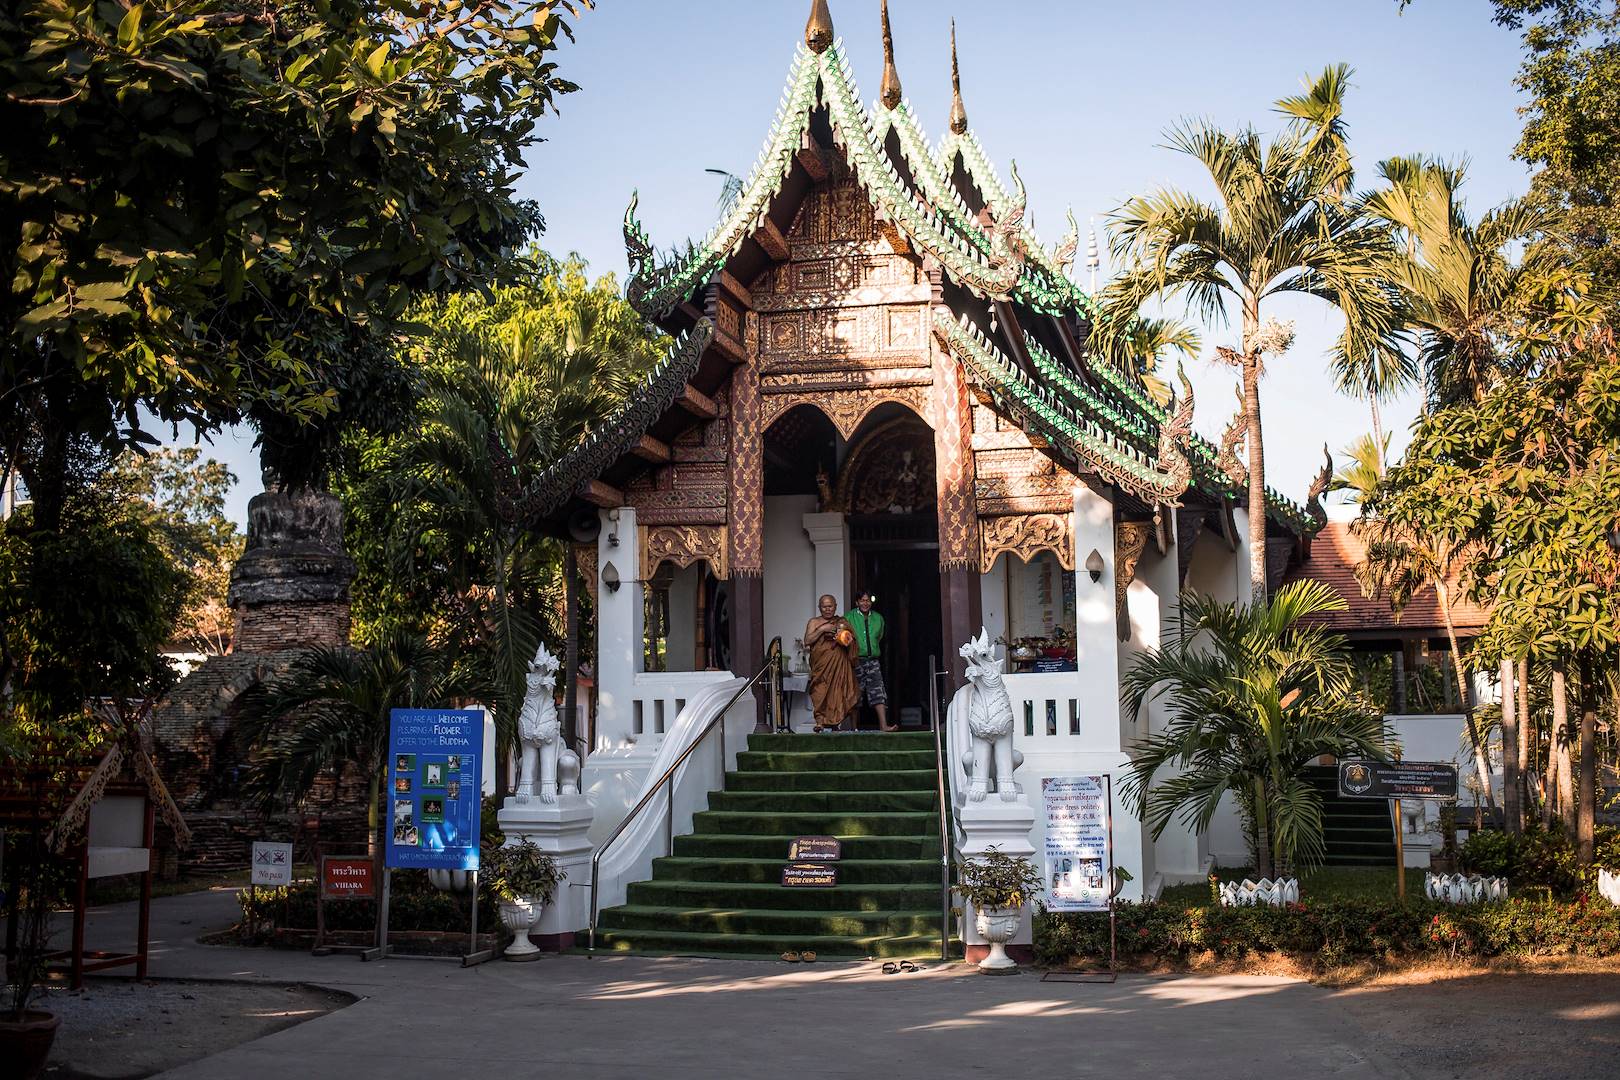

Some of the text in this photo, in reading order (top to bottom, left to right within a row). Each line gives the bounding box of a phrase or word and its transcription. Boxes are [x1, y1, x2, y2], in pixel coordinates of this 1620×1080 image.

[438, 714, 469, 724] WELCOME
[433, 724, 462, 735] FLOWER
[397, 737, 417, 746] OFFER
[439, 736, 470, 746] BUDDHA
[332, 865, 367, 876] พระวิหาร
